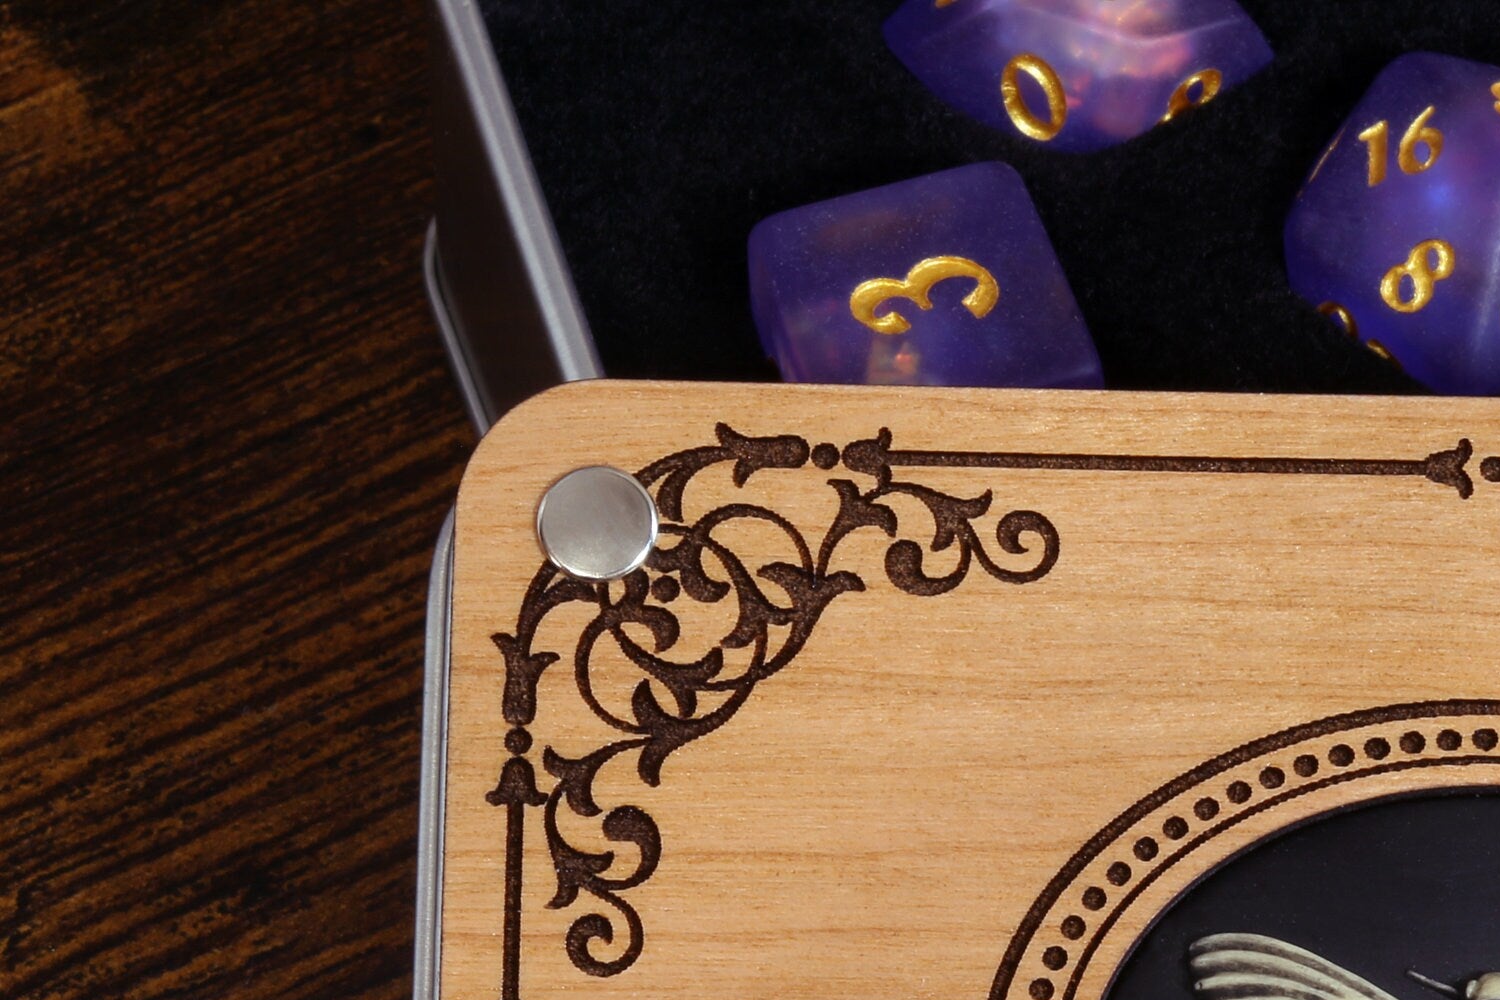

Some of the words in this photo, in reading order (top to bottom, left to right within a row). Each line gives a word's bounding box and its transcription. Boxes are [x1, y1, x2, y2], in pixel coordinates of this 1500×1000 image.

[1358, 105, 1444, 187] 16
[849, 255, 999, 334] 3
[1378, 239, 1455, 313] 8
